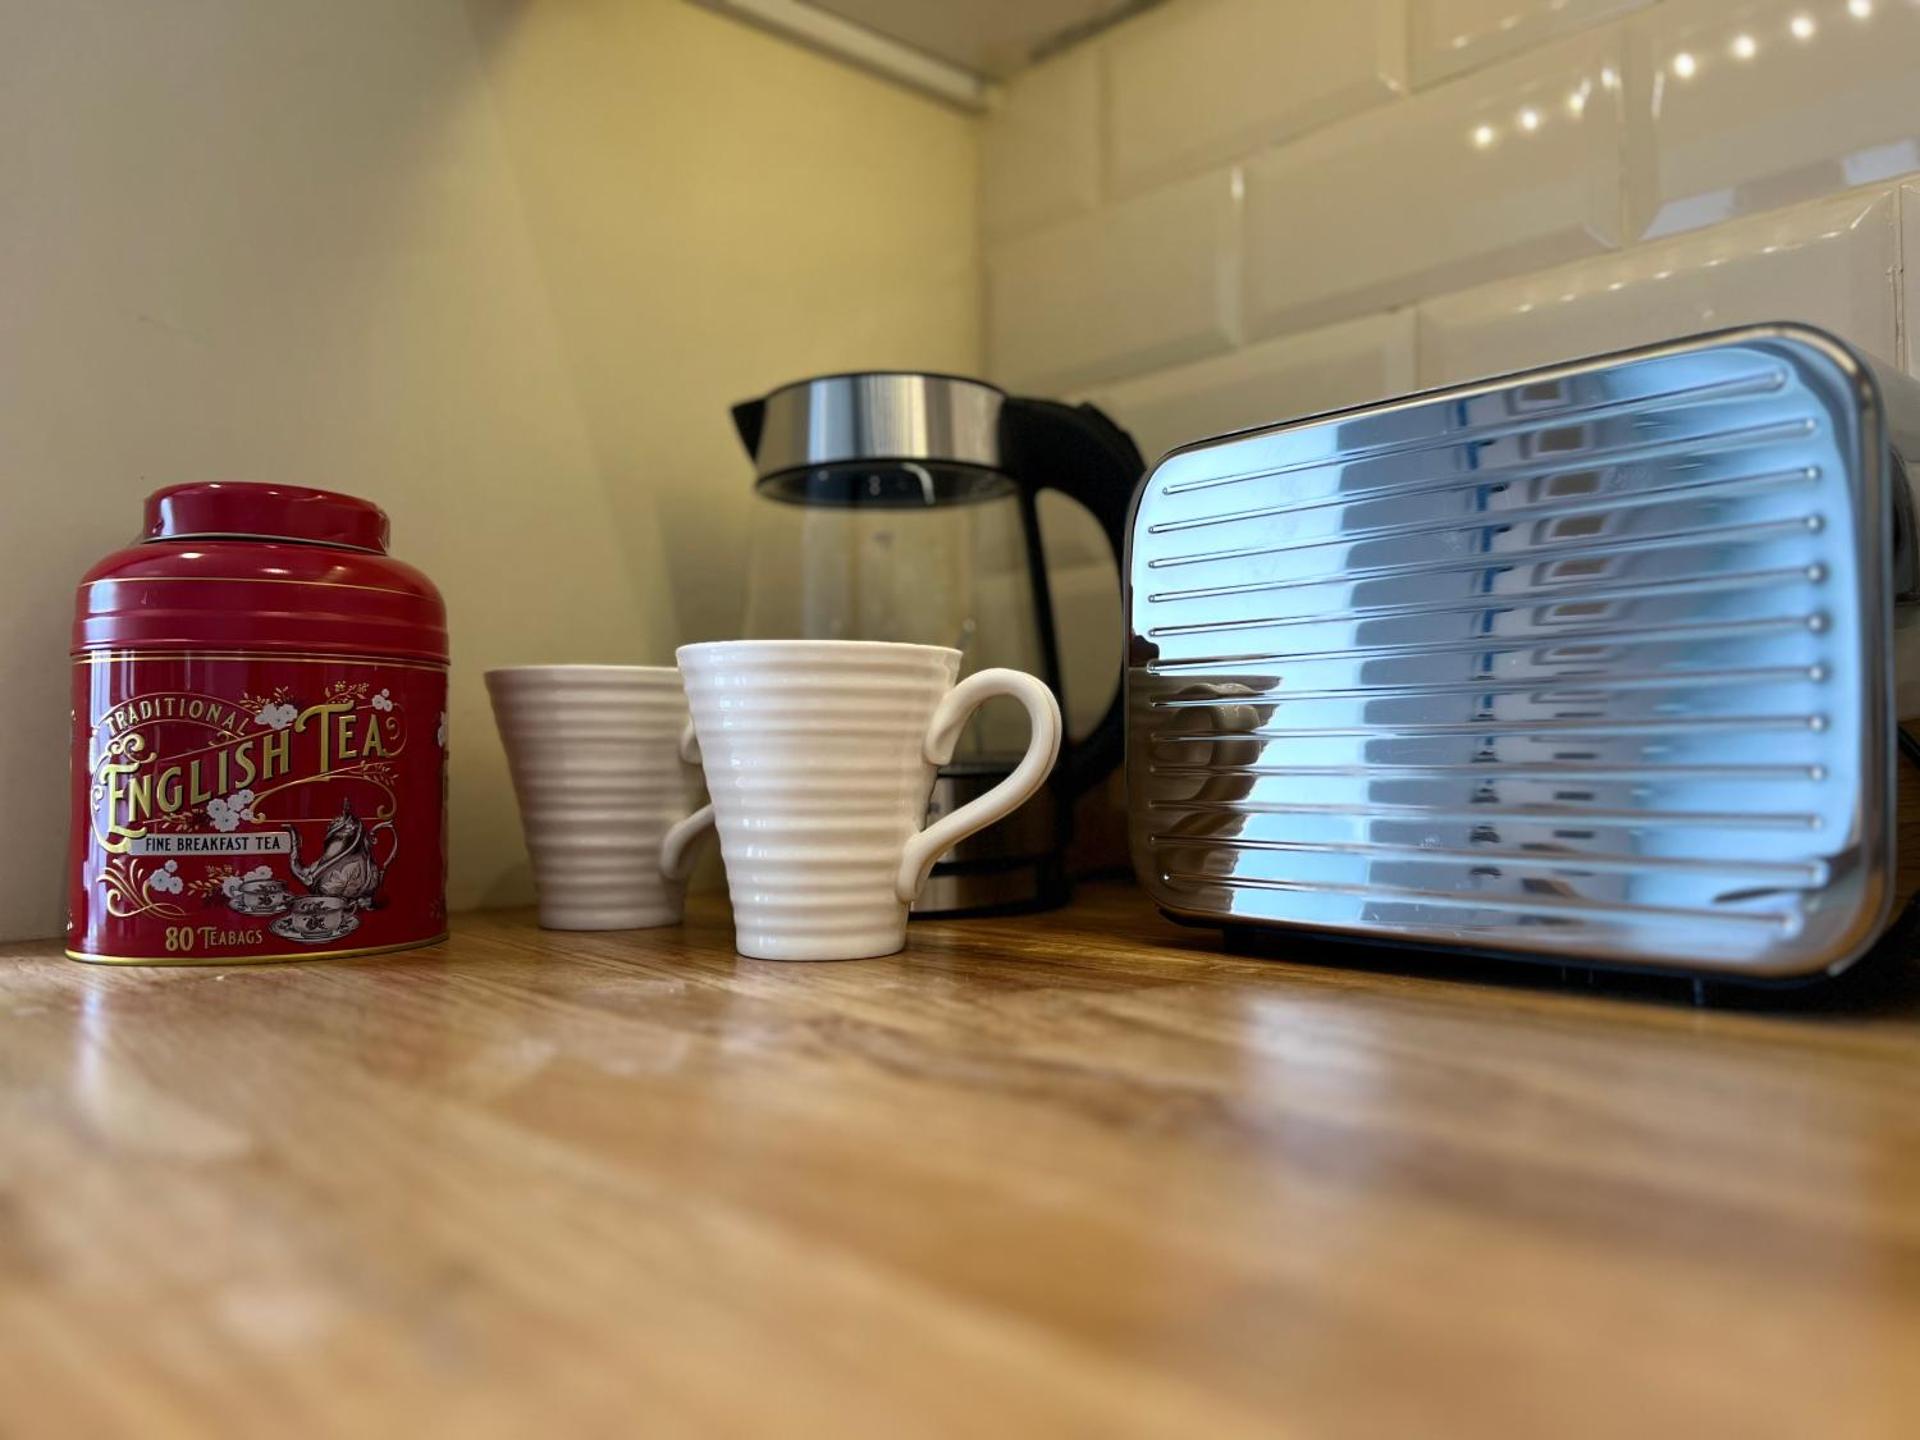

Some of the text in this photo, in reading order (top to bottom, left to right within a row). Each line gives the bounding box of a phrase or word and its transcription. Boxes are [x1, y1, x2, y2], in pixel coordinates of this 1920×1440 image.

[105, 697, 250, 737] TRADITIONAL
[97, 699, 387, 840] ENGLISH TEA
[145, 836, 281, 852] FINE BREAKFAST TEA
[165, 926, 264, 951] 80 TEABAGS
